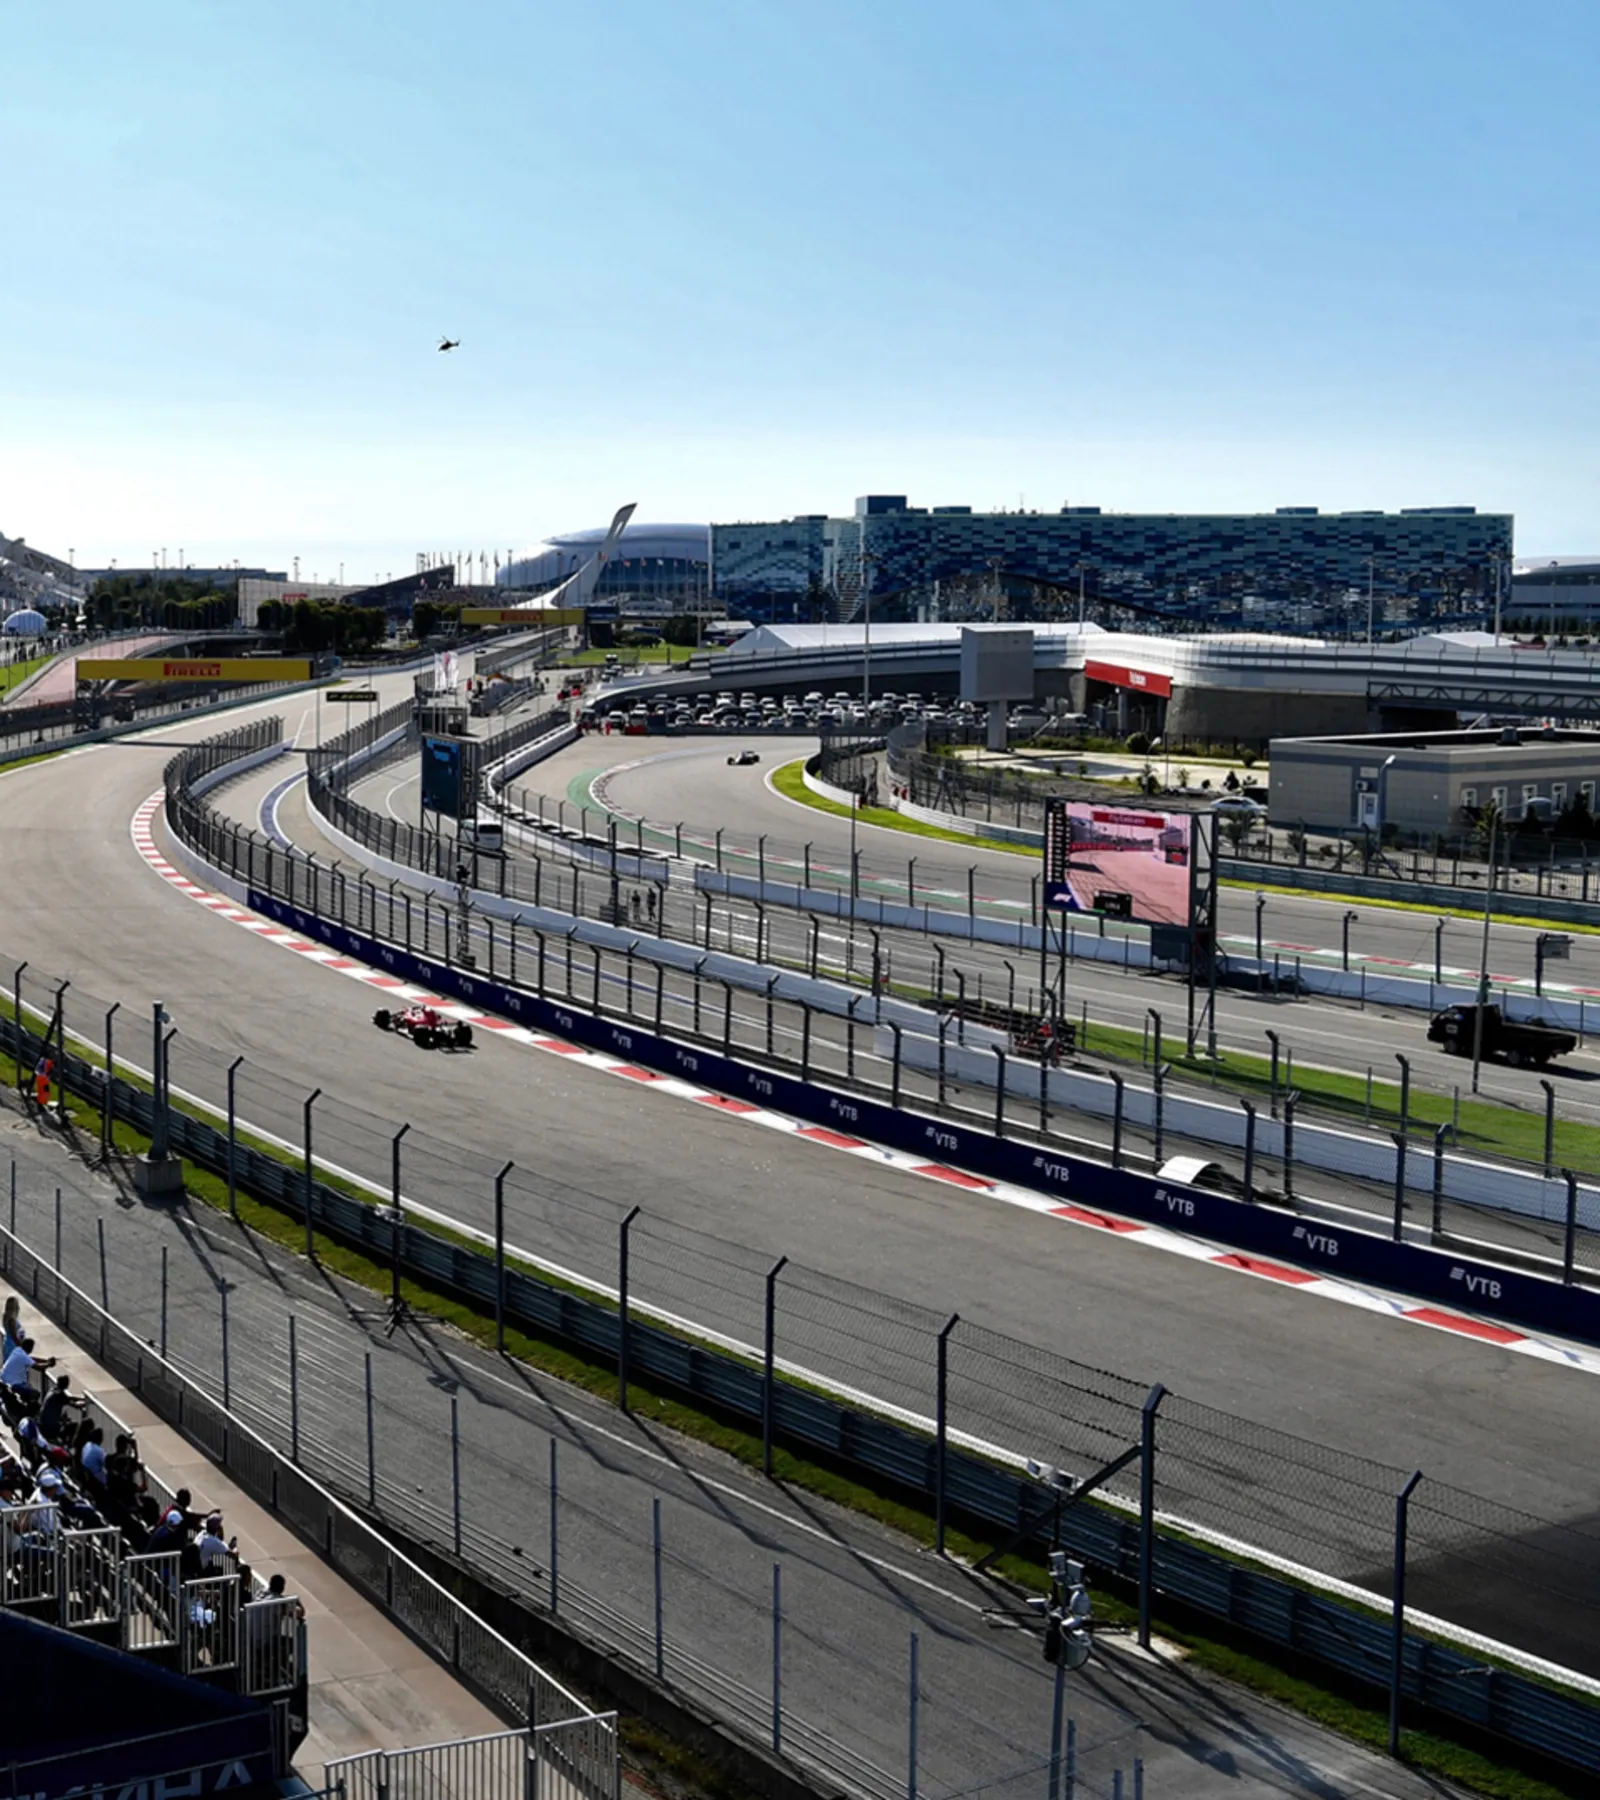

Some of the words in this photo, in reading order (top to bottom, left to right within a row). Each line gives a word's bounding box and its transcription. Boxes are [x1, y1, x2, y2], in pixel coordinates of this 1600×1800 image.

[163, 663, 221, 676] PIRELLI
[755, 1079, 773, 1095] VTB
[838, 1105, 859, 1121] VTB
[935, 1131, 958, 1151] VTB
[1043, 1161, 1070, 1182] VTB
[1167, 1195, 1195, 1217] VTB
[1306, 1233, 1339, 1256] VTB
[1465, 1274, 1502, 1299] VTB
